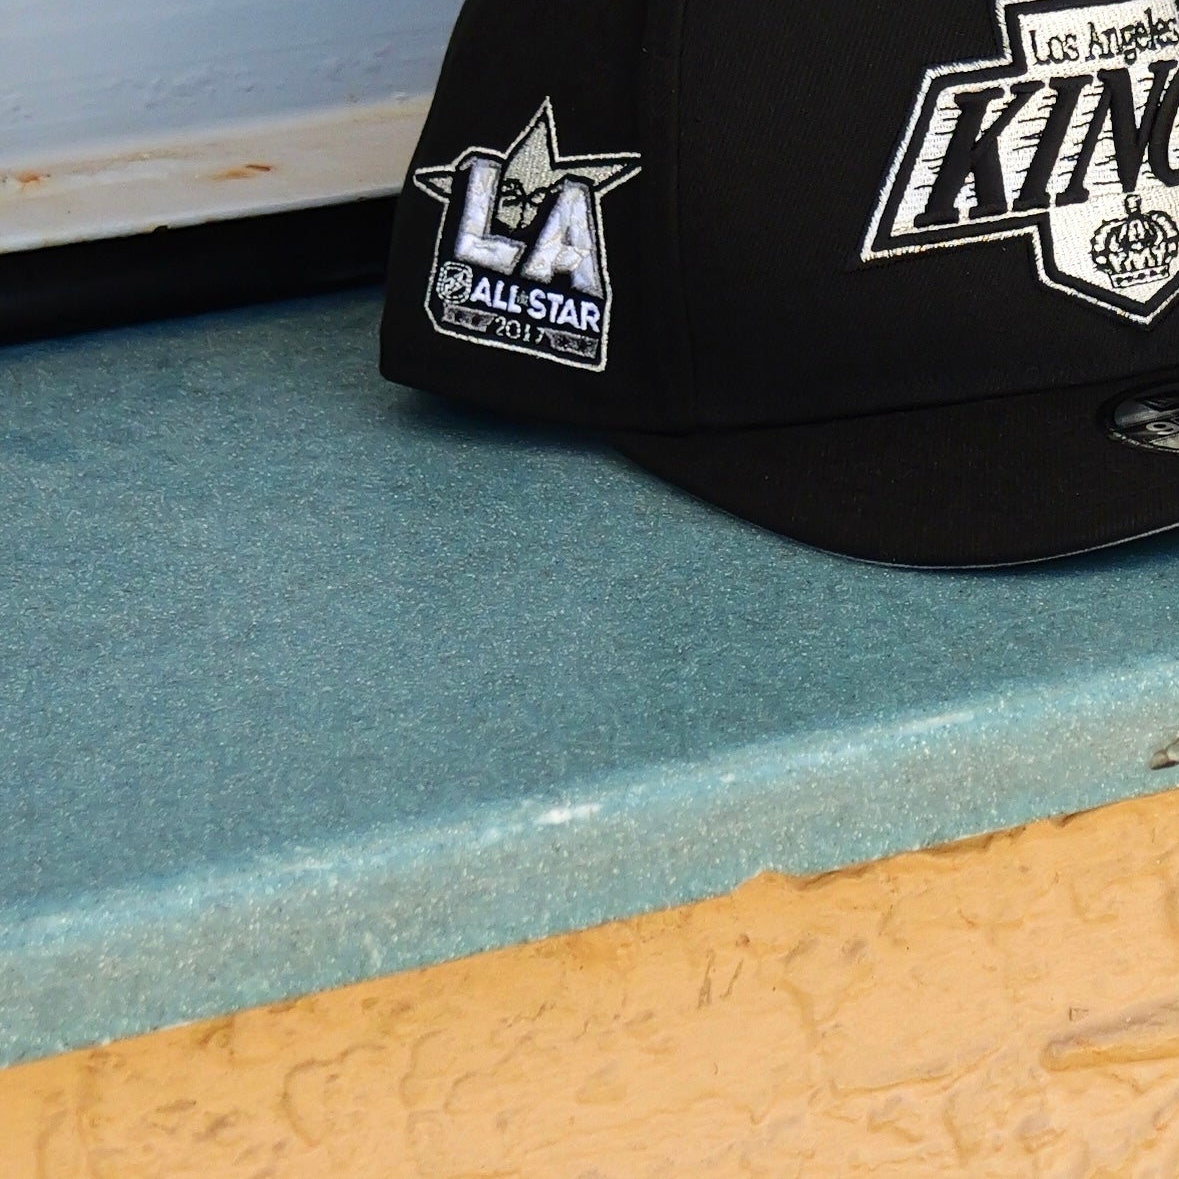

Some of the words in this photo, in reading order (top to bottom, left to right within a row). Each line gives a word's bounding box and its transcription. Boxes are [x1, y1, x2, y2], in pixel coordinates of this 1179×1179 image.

[1029, 29, 1078, 66] Los
[454, 156, 604, 299] LA
[495, 316, 546, 344] 2017
